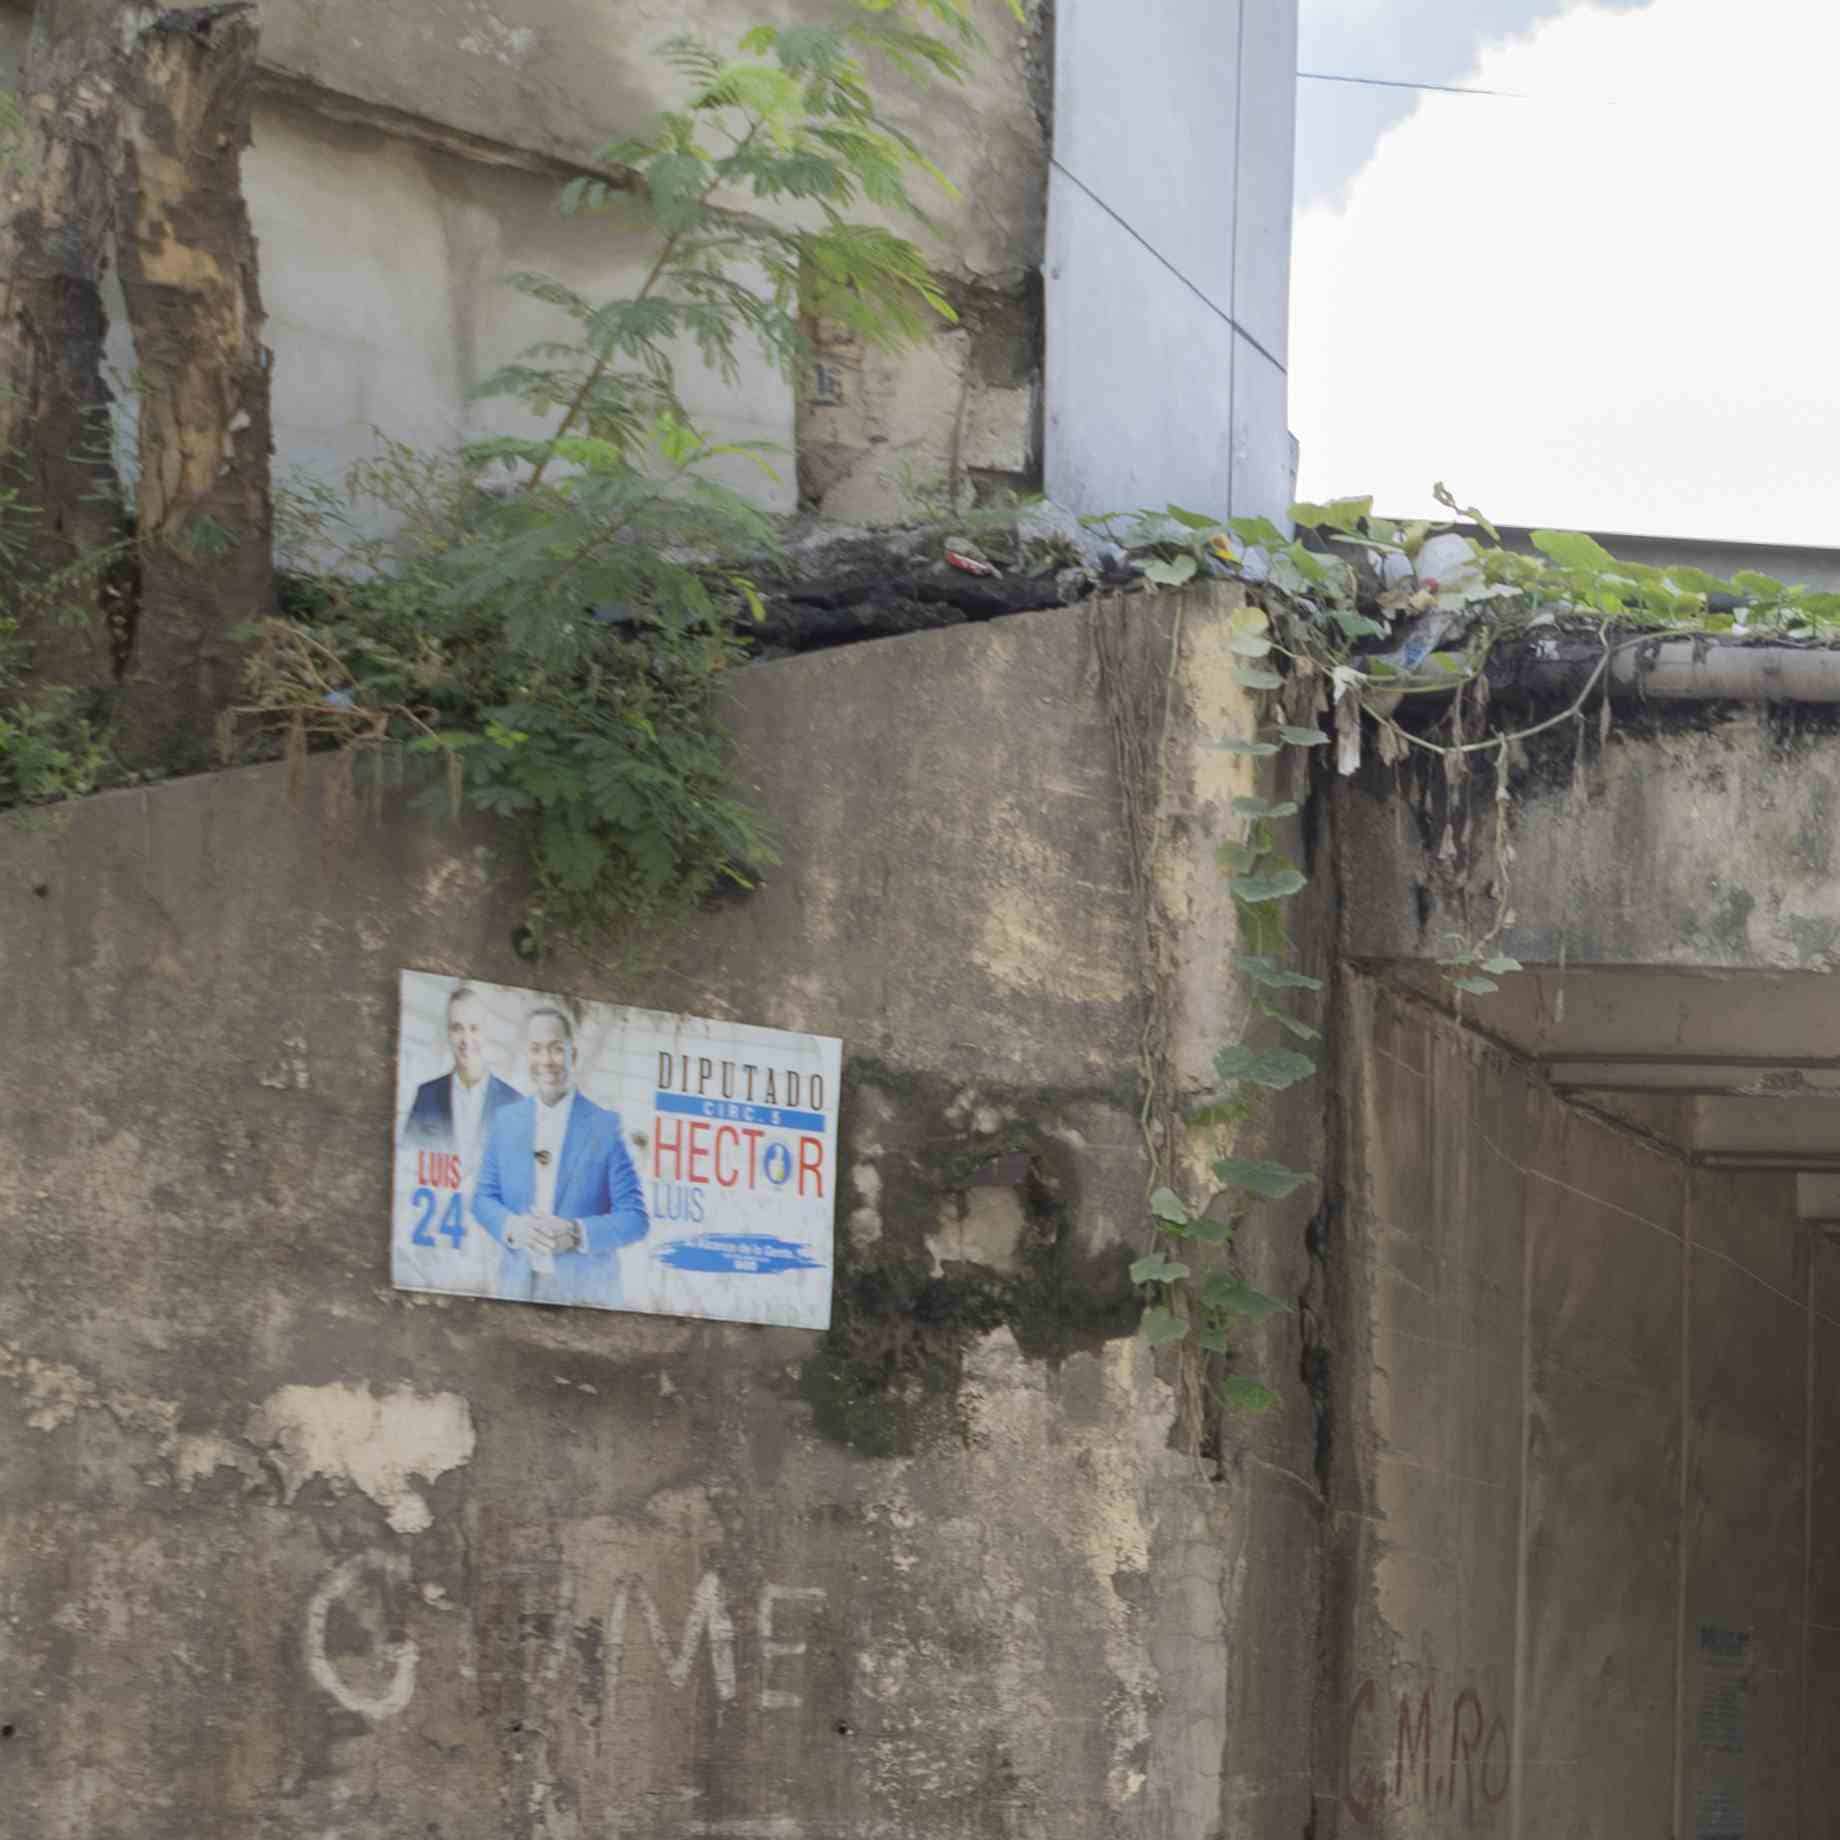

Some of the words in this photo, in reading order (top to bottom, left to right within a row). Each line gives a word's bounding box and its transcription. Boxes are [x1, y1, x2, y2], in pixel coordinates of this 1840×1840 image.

[657, 1051, 825, 1112] DIPUTADO
[416, 1150, 462, 1191] LUIS
[654, 1115, 825, 1198] HECTOR
[409, 1187, 466, 1250] 24
[652, 1182, 705, 1223] LUIS
